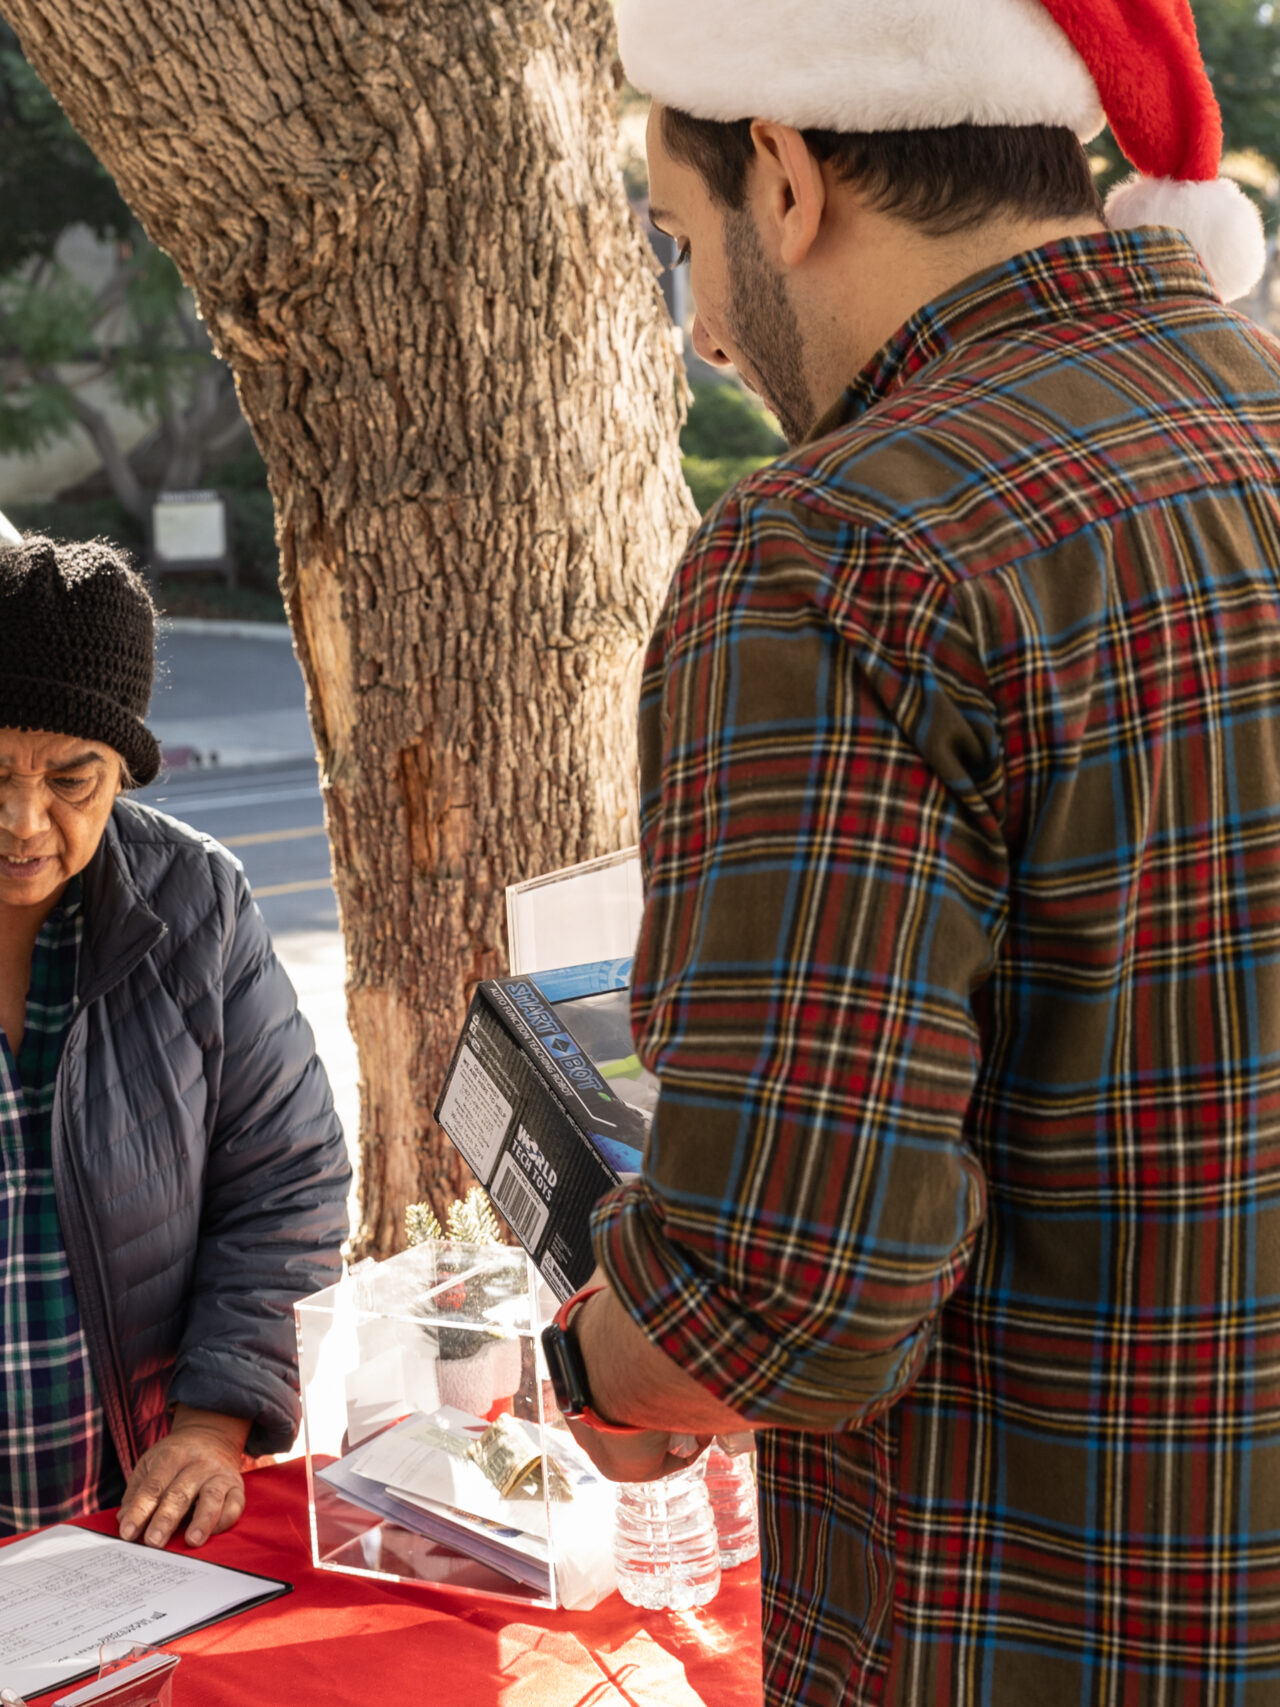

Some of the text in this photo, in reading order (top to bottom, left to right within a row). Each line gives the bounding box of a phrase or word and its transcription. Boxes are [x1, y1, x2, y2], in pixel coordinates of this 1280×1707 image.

[490, 988, 505, 1006] AUTO
[504, 1003, 529, 1040] FUNCTION
[528, 1038, 554, 1076] TEACHING
[553, 1073, 574, 1097] ROBOT
[506, 982, 604, 1090] SMART BOT
[512, 1139, 532, 1174] TECH
[531, 1169, 553, 1202] TOYS
[515, 1123, 558, 1188] WORLD
[552, 1264, 574, 1297] WARNIN
